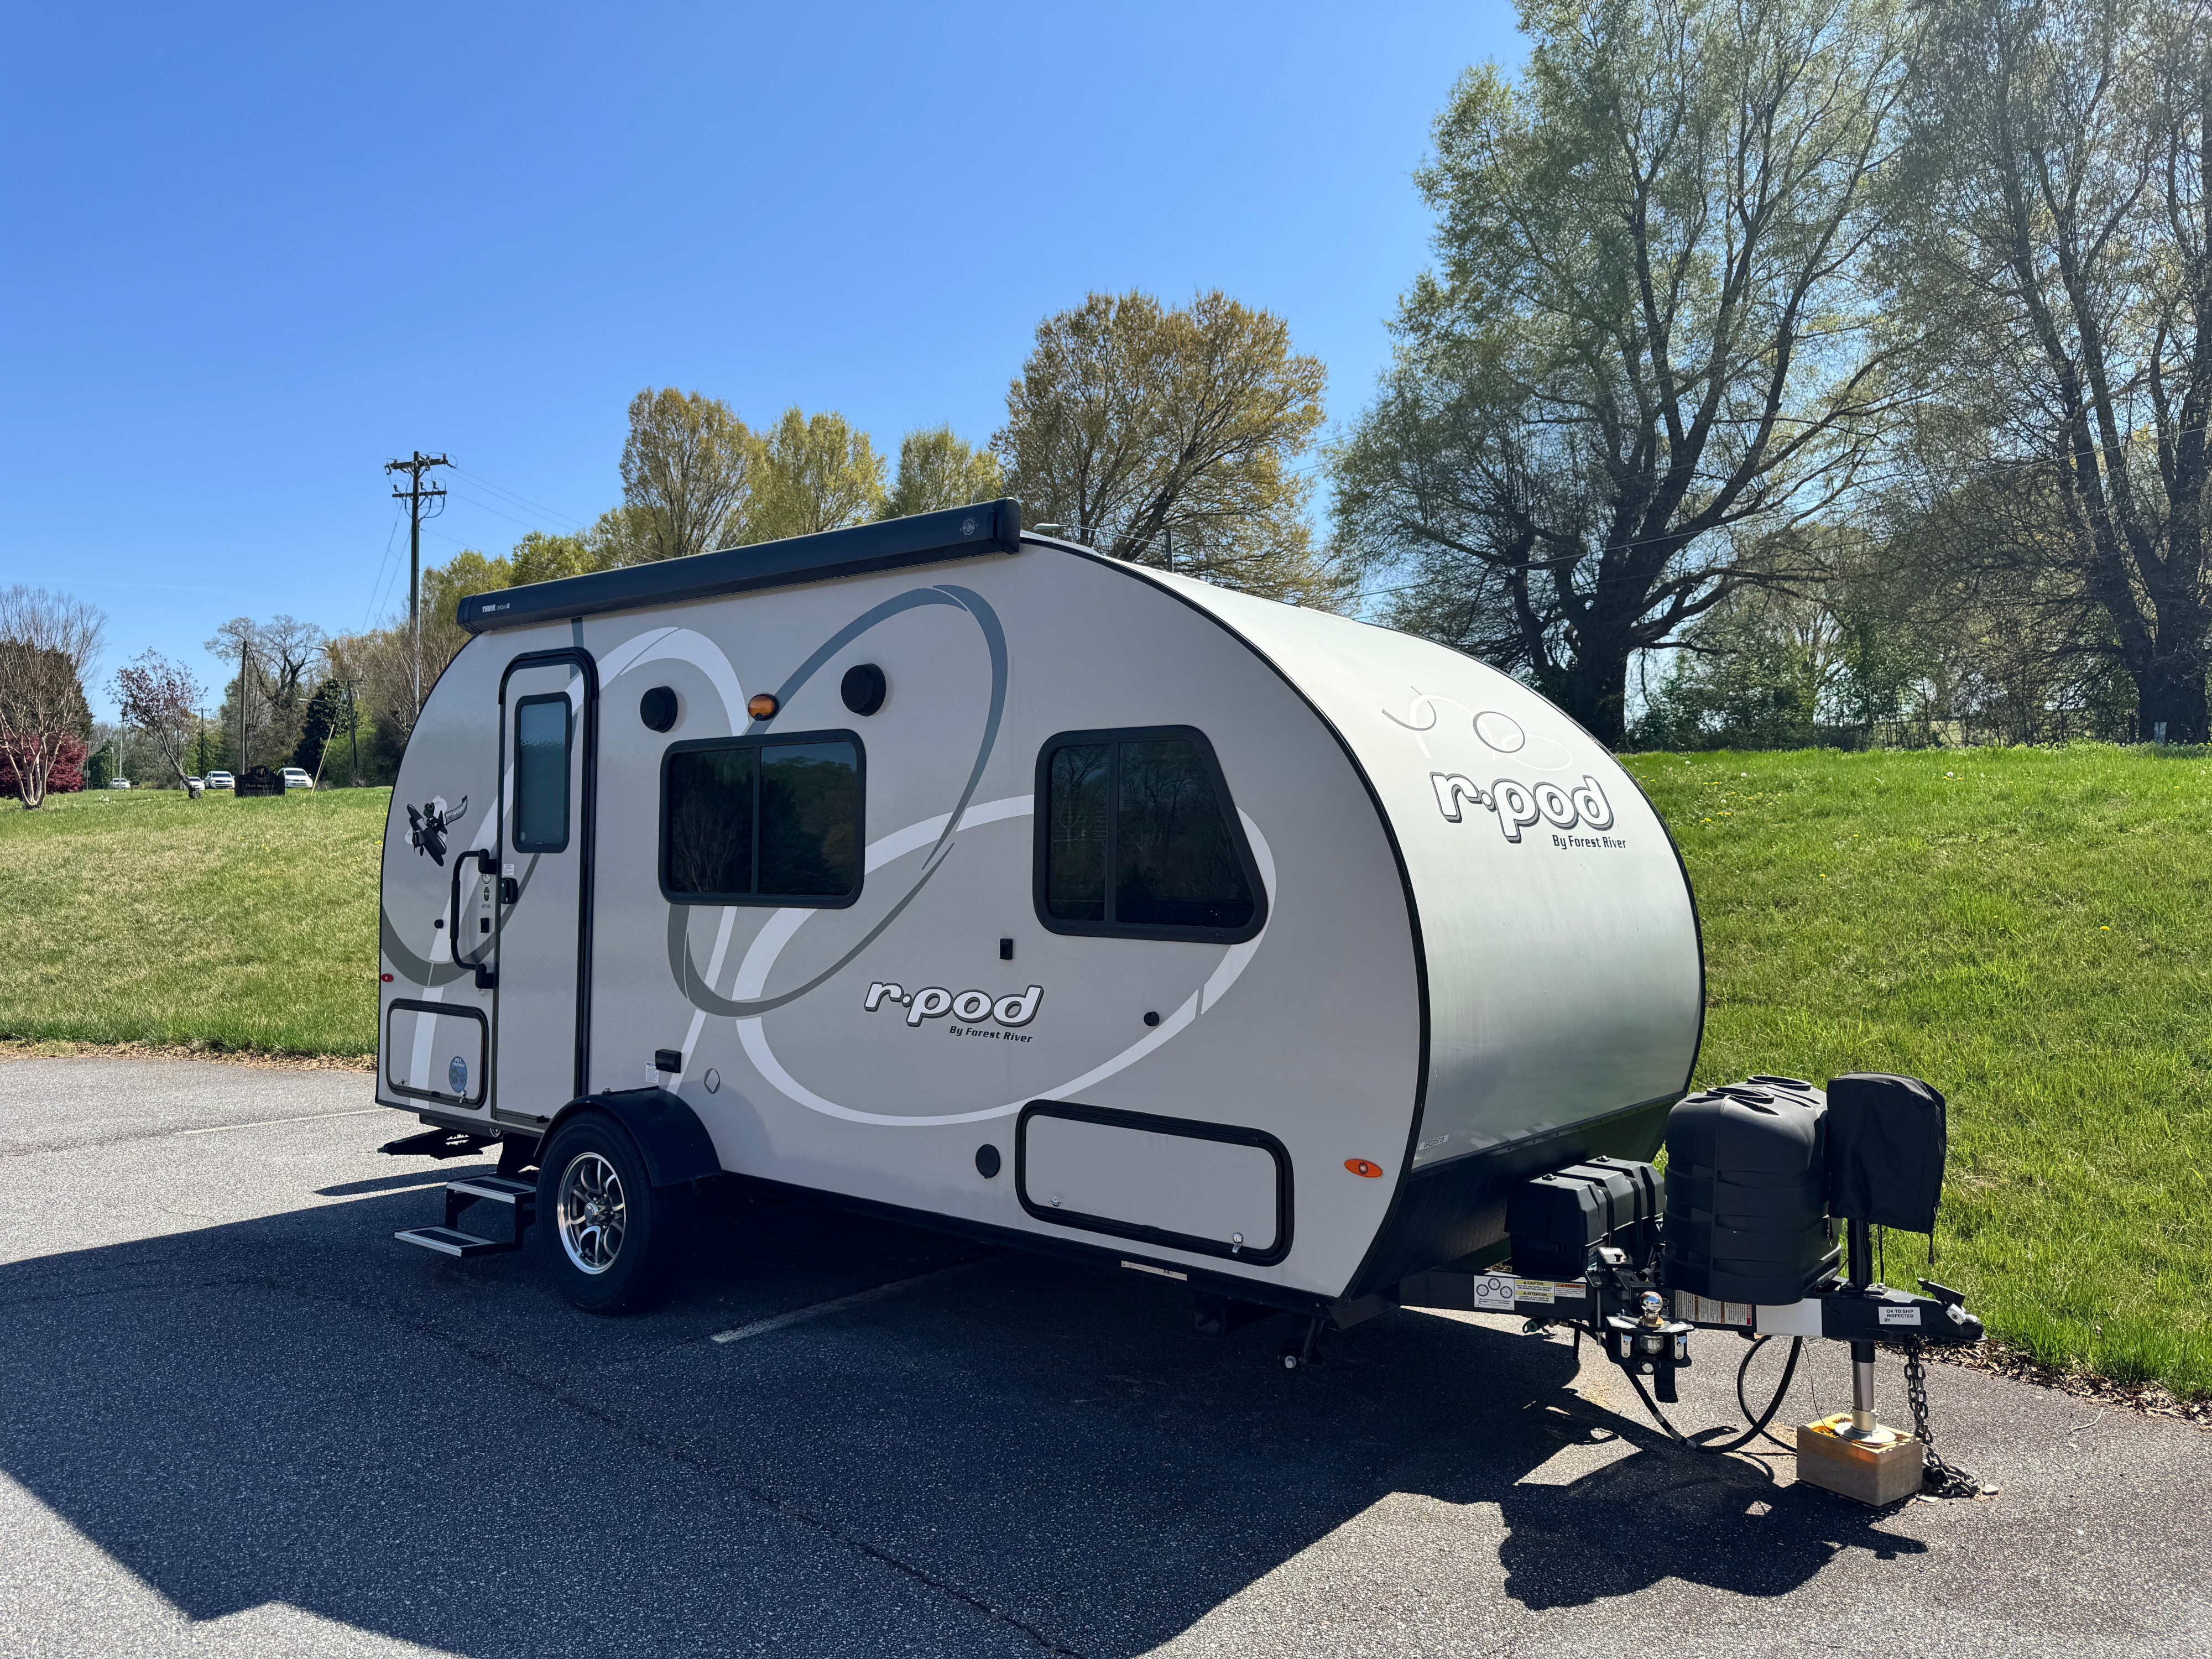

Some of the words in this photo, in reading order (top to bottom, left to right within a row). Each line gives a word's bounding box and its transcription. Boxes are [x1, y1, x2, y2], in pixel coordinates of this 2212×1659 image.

[482, 604, 496, 613] THULE
[1552, 834, 1567, 849] By
[1568, 835, 1601, 848] Forest
[1602, 837, 1626, 848] River
[949, 1025, 963, 1036] By
[966, 1027, 1000, 1039] Forest
[1003, 1032, 1033, 1043] River
